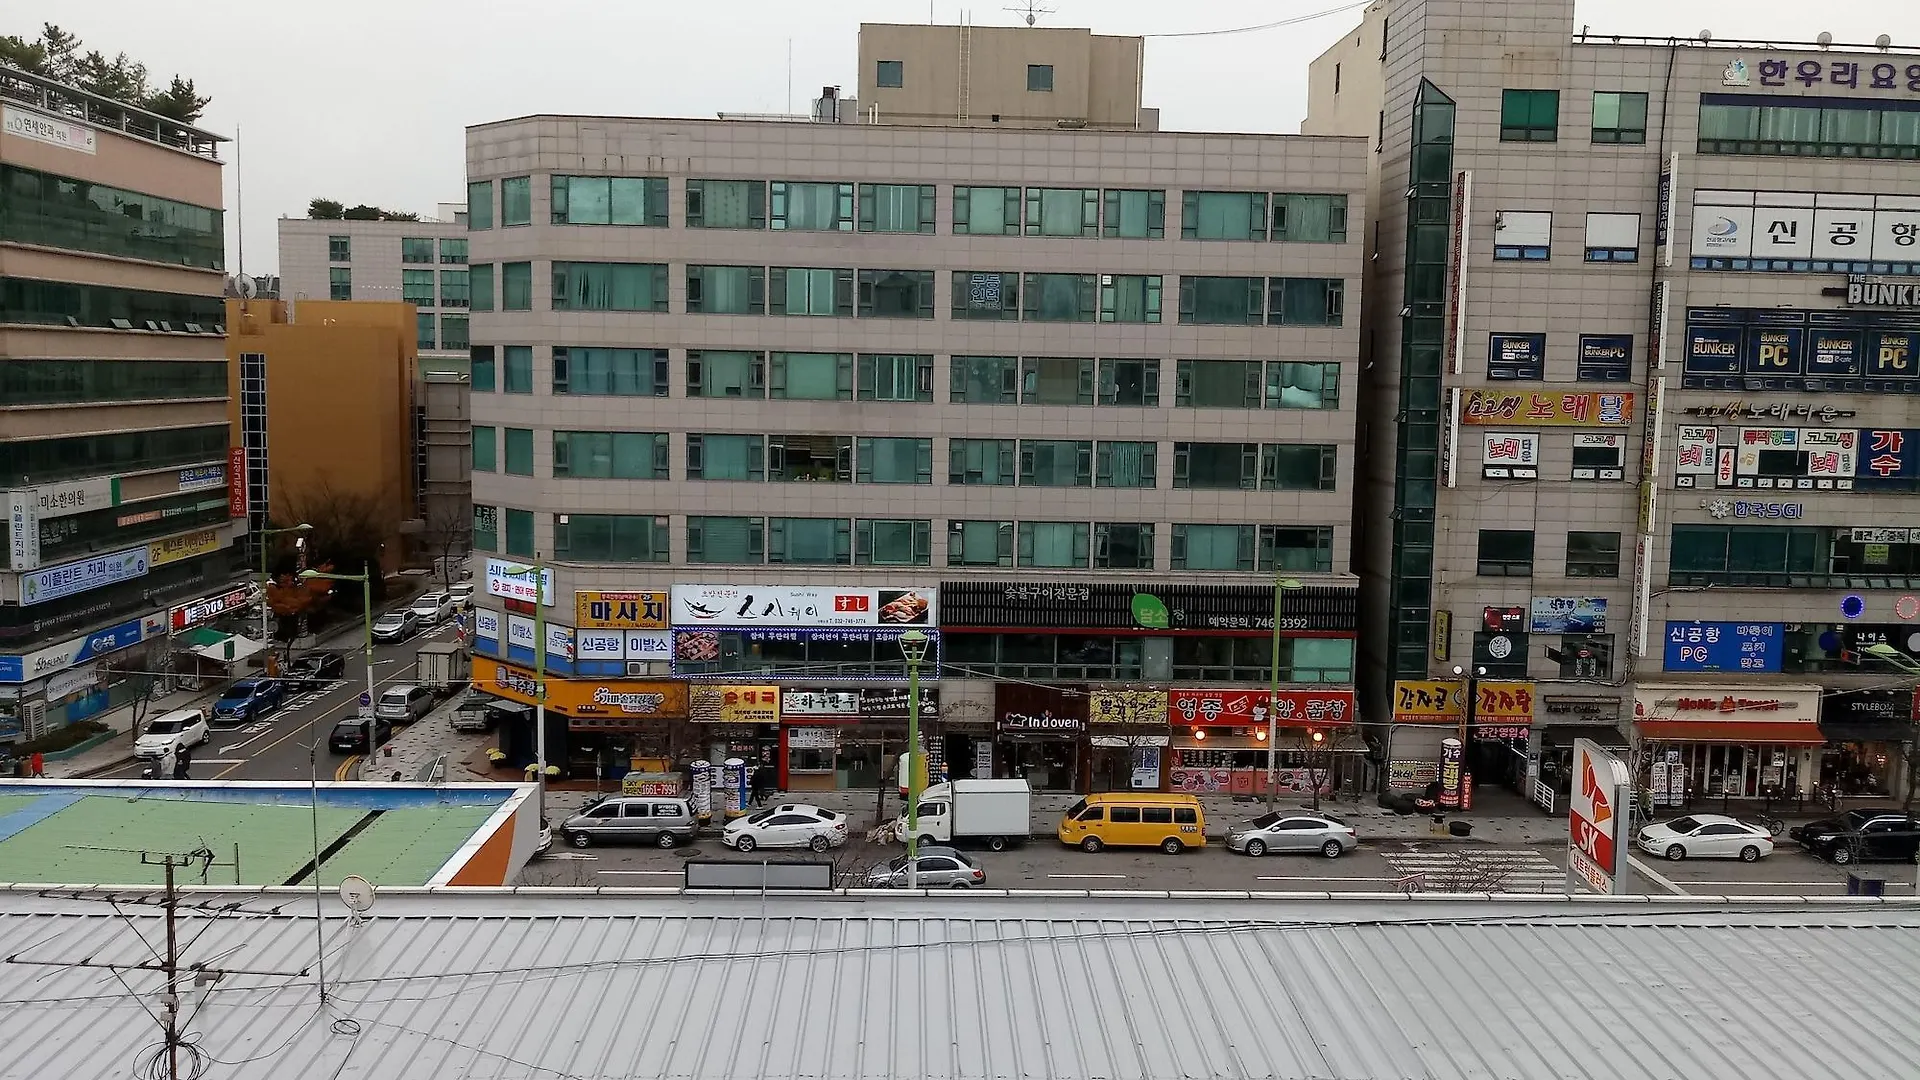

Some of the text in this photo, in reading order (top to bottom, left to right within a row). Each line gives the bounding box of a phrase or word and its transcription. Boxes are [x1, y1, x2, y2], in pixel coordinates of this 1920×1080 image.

[1849, 274, 1866, 283] THE
[1502, 341, 1530, 349] BUNKER
[1693, 343, 1735, 354] BUNKER
[1817, 340, 1853, 349] BUNKER
[1881, 337, 1908, 345] BUNKER
[1610, 347, 1625, 358] PC
[1759, 345, 1788, 366] PC
[1878, 347, 1908, 369] PC
[1526, 393, 1590, 420] 노래
[1683, 429, 1716, 443] 고고씽
[1744, 430, 1796, 445] 뮤직뱅크
[1805, 432, 1854, 449] 고고씽
[1489, 438, 1519, 459] 노래
[1679, 445, 1702, 466] 노래
[1870, 431, 1904, 476] 가수
[1720, 452, 1731, 481] 4층
[1811, 452, 1838, 473] 노래
[1735, 502, 1803, 519] 한국SGI
[41, 566, 82, 588] 이플란트
[87, 560, 106, 576] 치과
[1005, 586, 1090, 600] 숯불구이전문점
[591, 602, 663, 621] 마사지
[838, 596, 867, 610] すし
[478, 616, 497, 631] 신공항
[512, 623, 532, 640] 이발소
[1736, 626, 1773, 638] 바둑이
[1671, 626, 1721, 643] 신공항
[1857, 632, 1887, 641] 나이스
[582, 637, 620, 652] 신공항
[630, 638, 668, 652] 이발소
[1680, 646, 1708, 663] PC
[1399, 686, 1447, 710] 감자골
[1175, 697, 1224, 721] 영종
[1443, 747, 1461, 759] 가수
[641, 783, 677, 795] 1661-7994
[1579, 820, 1599, 860] SK
